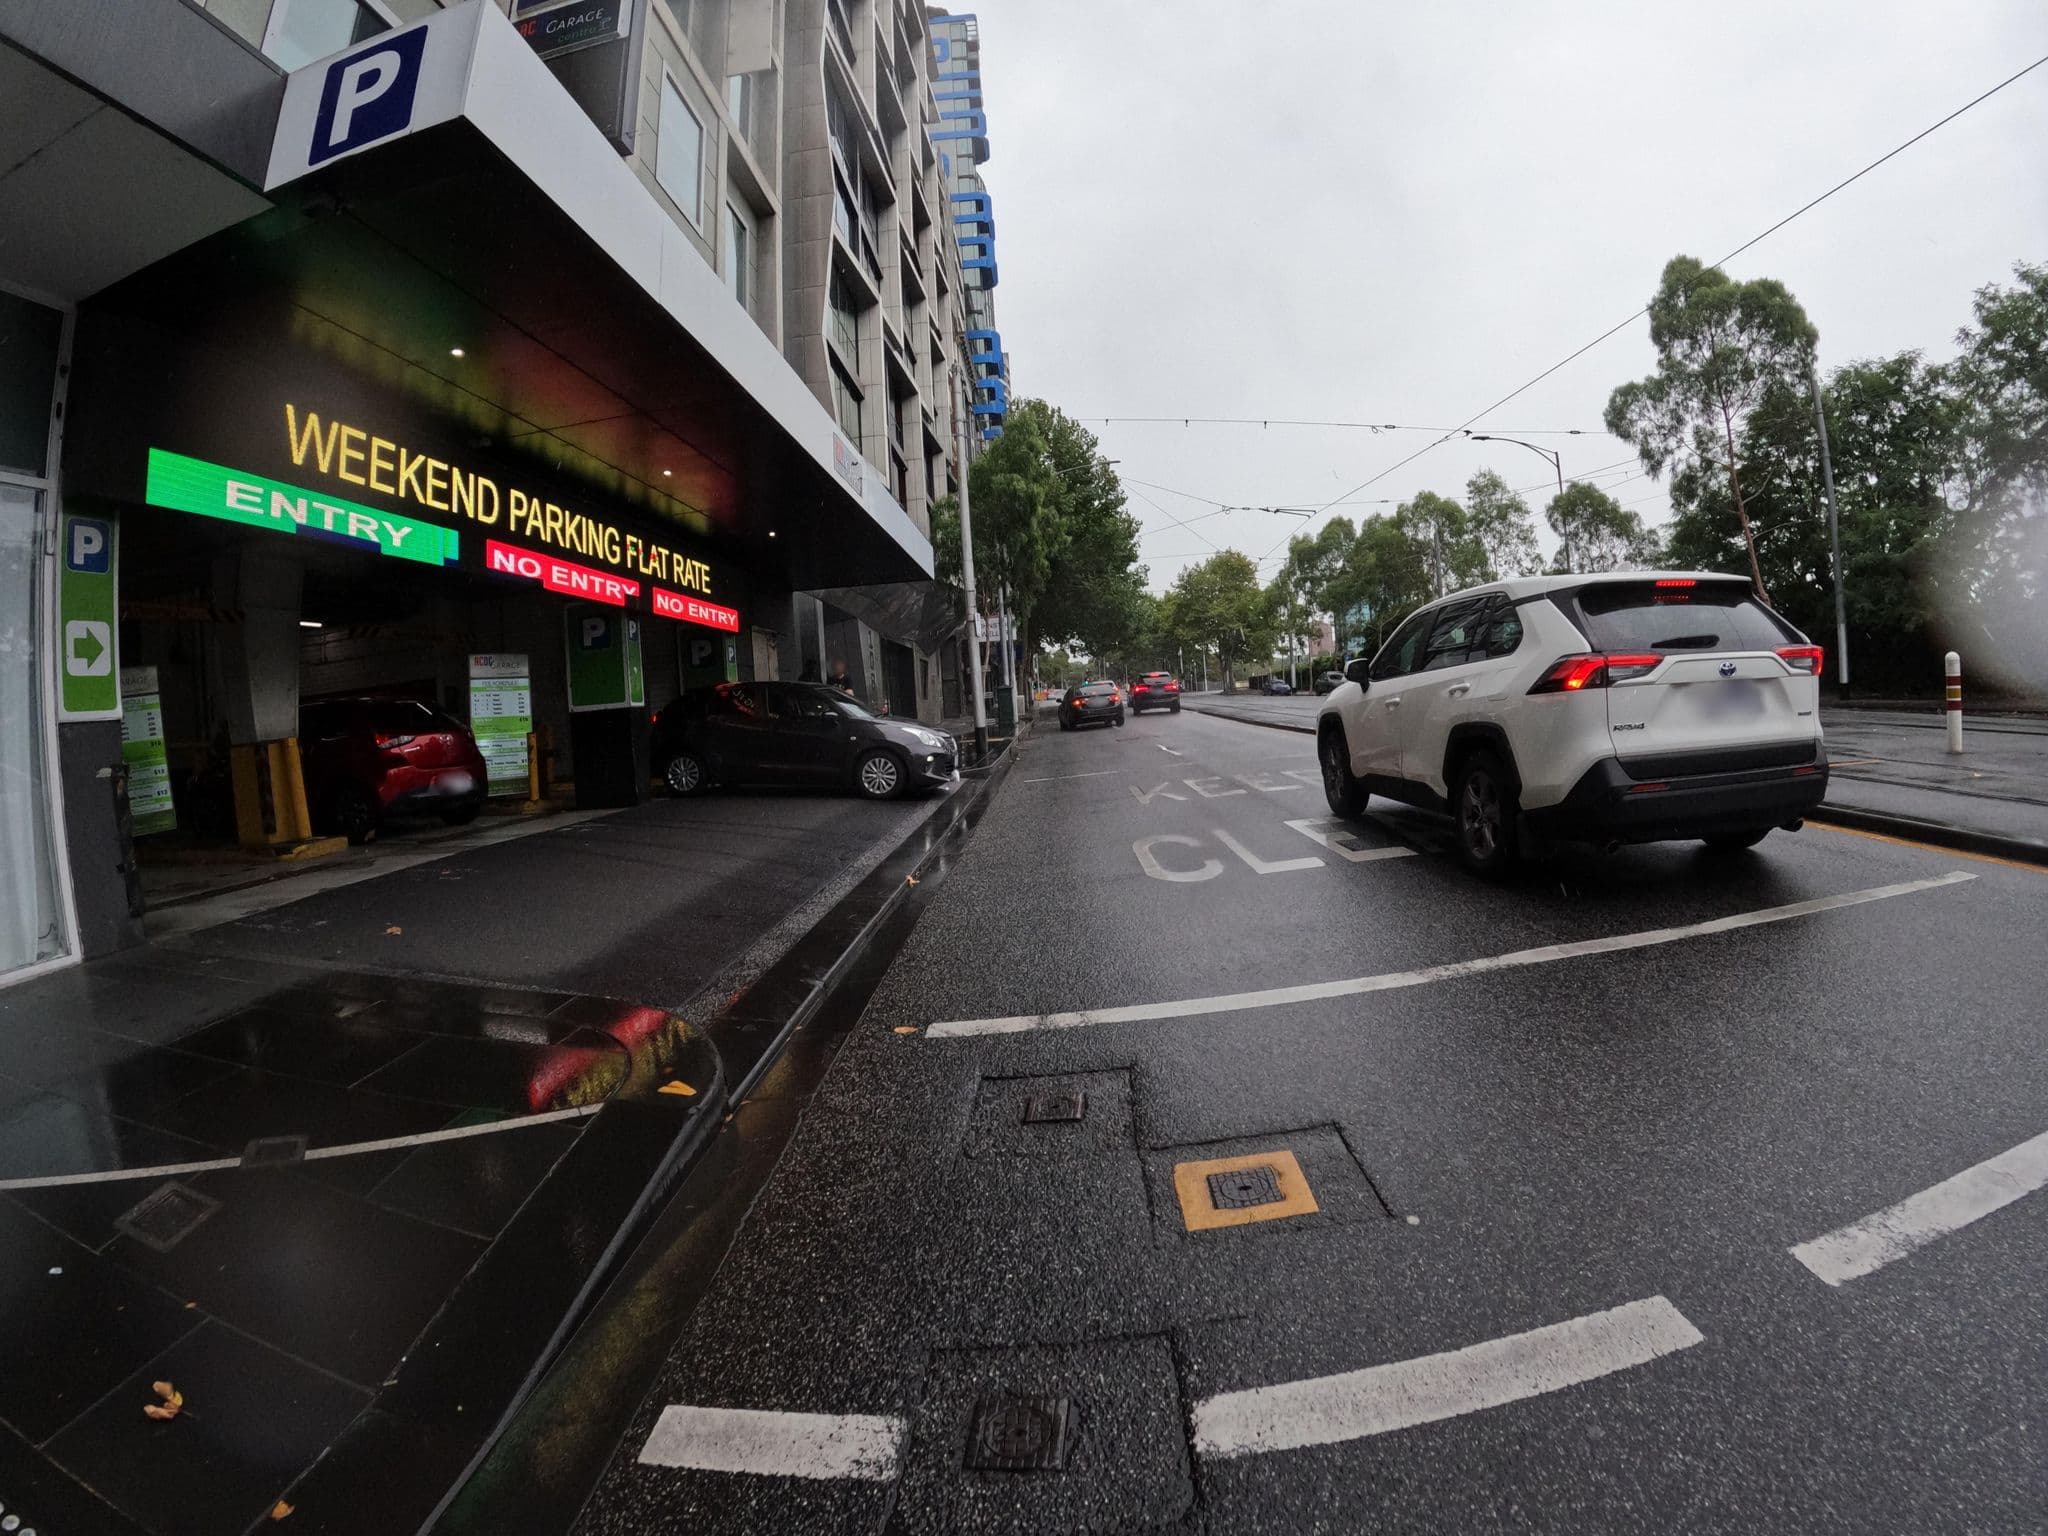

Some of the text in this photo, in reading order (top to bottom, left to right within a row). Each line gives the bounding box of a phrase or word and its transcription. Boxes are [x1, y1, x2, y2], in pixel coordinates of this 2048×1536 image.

[546, 8, 605, 34] GARAGE
[329, 50, 401, 147] P
[225, 479, 413, 548] ENTRY
[286, 403, 711, 595] WEEKEND PARKING FLAT RATE
[73, 525, 103, 565] P
[494, 549, 637, 600] NO ENTRY
[656, 593, 737, 627] NO ENTRY
[582, 617, 606, 646] P
[628, 620, 637, 638] P
[690, 640, 712, 665] P
[728, 646, 735, 661] P
